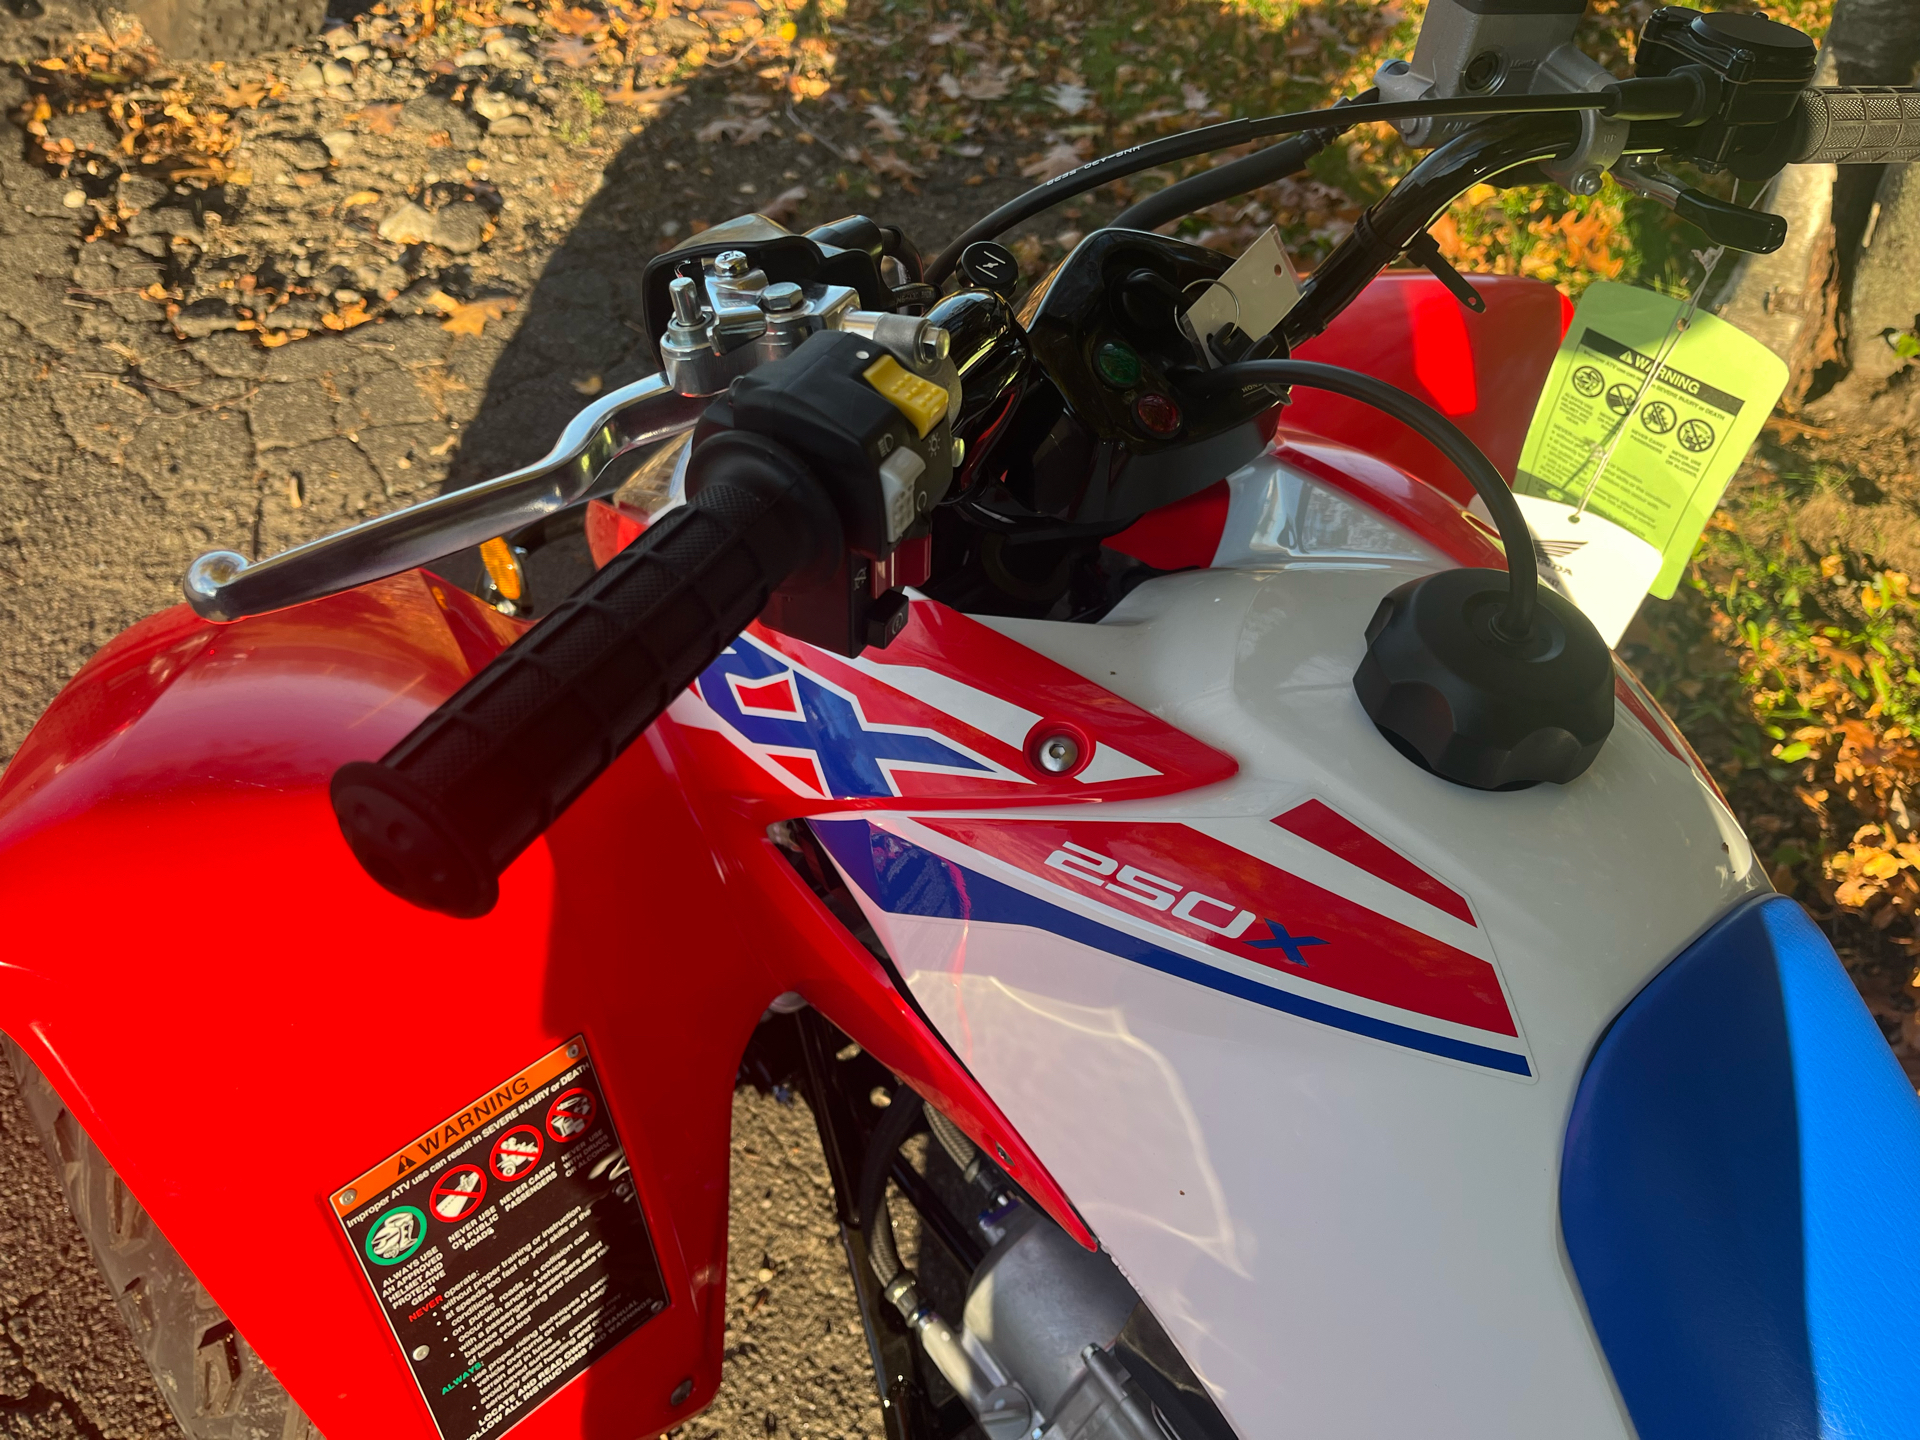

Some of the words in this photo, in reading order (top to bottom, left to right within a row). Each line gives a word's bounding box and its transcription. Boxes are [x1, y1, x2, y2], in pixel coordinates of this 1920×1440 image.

[417, 1074, 530, 1158] WARNING
[345, 1193, 391, 1230] Improper
[389, 1179, 411, 1200] ATV
[411, 1169, 429, 1186] use
[429, 1157, 447, 1174] can
[445, 1139, 472, 1162] result
[471, 1132, 482, 1145] in
[481, 1108, 519, 1138] SEVERE
[517, 1086, 550, 1114] INJURY
[550, 1081, 560, 1093] or
[559, 1060, 589, 1086] DEATH
[560, 1140, 586, 1162] NEVER
[588, 1128, 603, 1143] USE
[563, 1152, 582, 1170] WITH
[582, 1133, 608, 1156] DRUGS
[564, 1164, 577, 1178] OR
[576, 1140, 611, 1169] ALCOHOL
[499, 1181, 528, 1206] NEVER
[527, 1161, 556, 1186] CARRY
[504, 1170, 557, 1212] PASSENGERS
[447, 1218, 477, 1243] NEVER
[477, 1204, 496, 1222] USE
[451, 1235, 467, 1250] ON
[466, 1212, 499, 1239] PUBLIC
[463, 1225, 494, 1252] ROADS
[381, 1258, 419, 1289] ALWAYS
[418, 1244, 438, 1263] USE
[381, 1283, 396, 1298] AN
[395, 1251, 443, 1288] APPROVED
[388, 1276, 421, 1303] HELMET
[420, 1260, 443, 1281] AND
[391, 1268, 446, 1310] PROTECTIVE
[408, 1294, 443, 1323] NEVER
[442, 1268, 480, 1299] operate:
[410, 1284, 436, 1307] GEAR
[466, 1412, 503, 1440] OLLOW
[503, 1397, 522, 1416] ALL
[522, 1346, 587, 1401] INSTRUCTIONS
[587, 1331, 606, 1350] AND
[608, 1296, 652, 1335] WARNINGS
[477, 1393, 516, 1426] LOCATE
[516, 1376, 537, 1397] AND
[538, 1356, 563, 1379] READ
[603, 1298, 638, 1329] MANUAL
